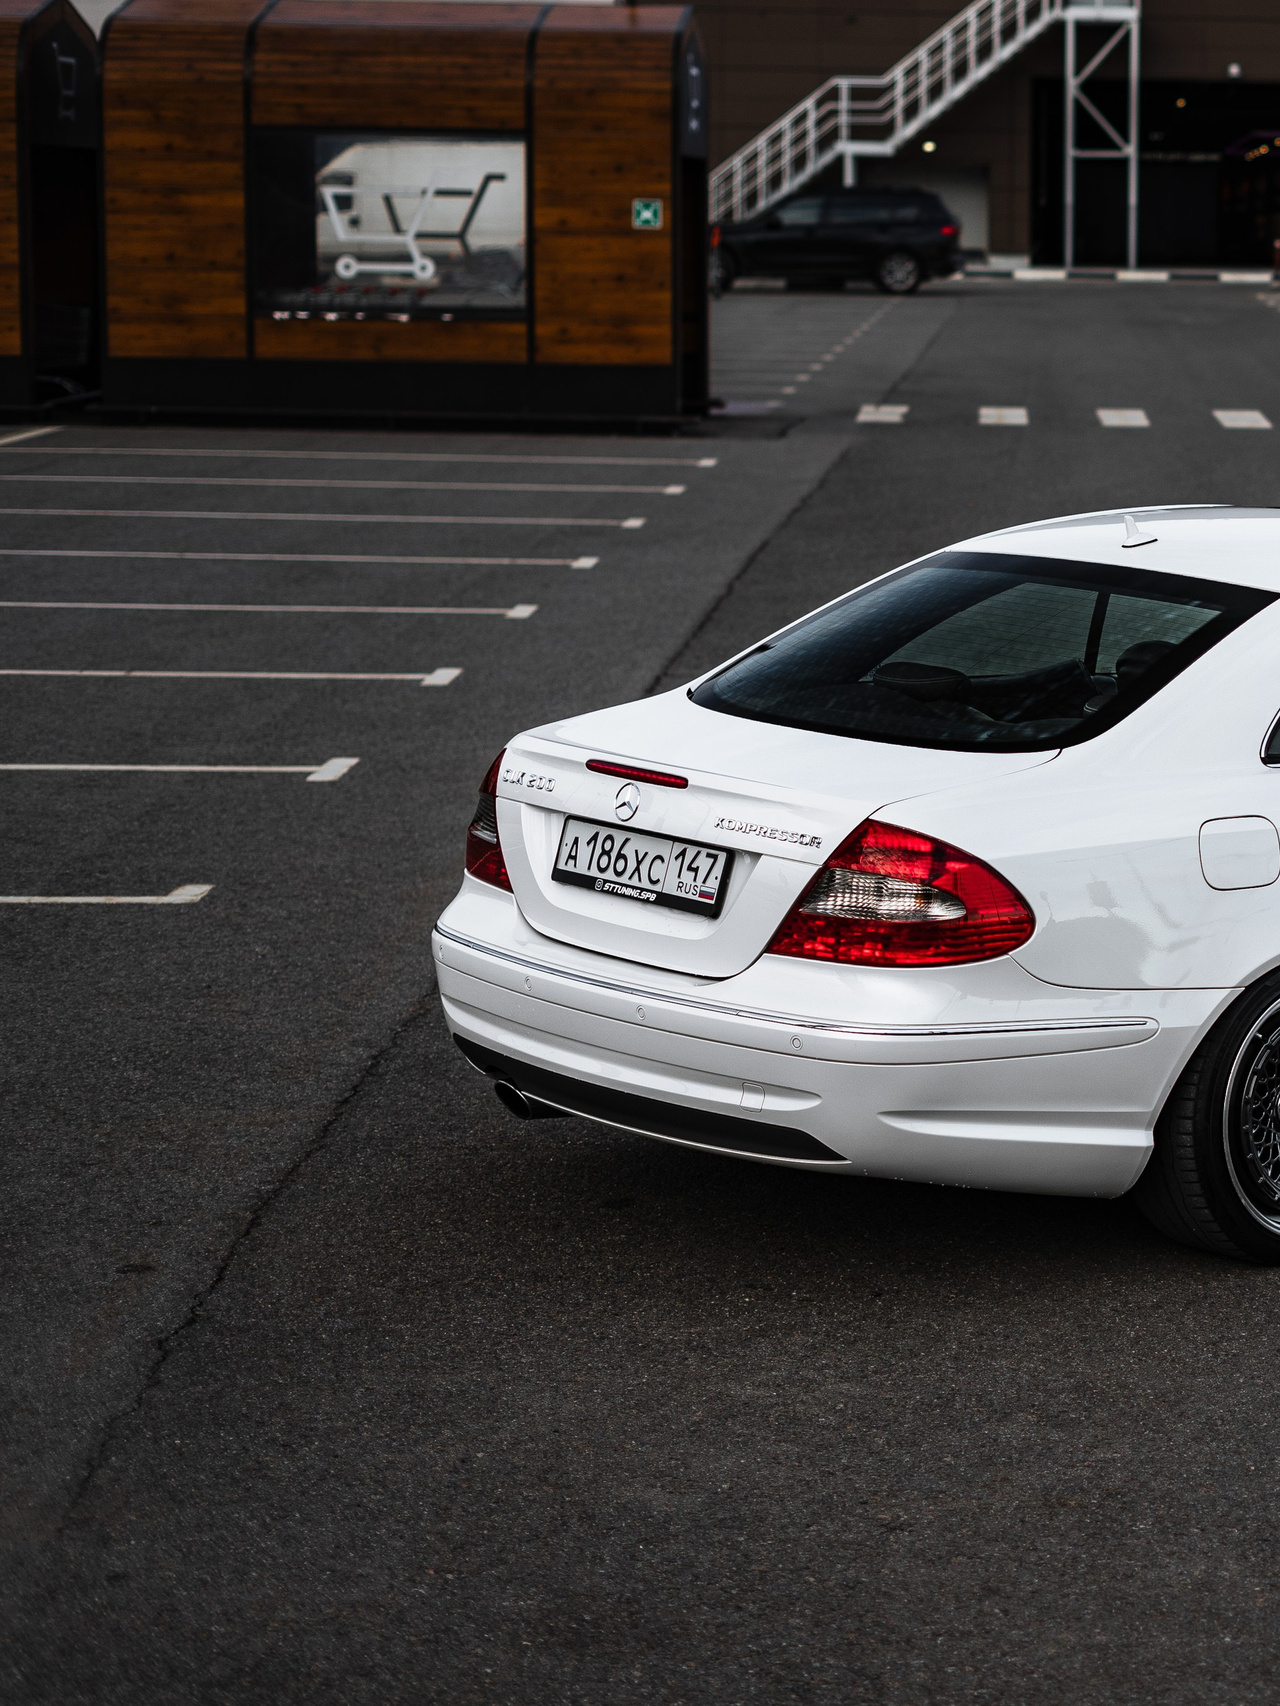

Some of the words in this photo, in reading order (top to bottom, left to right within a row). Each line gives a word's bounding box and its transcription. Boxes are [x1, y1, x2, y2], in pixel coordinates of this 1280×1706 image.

[503, 769, 526, 786] CLK
[527, 774, 556, 793] 200
[714, 816, 822, 849] KOMPRESSOR
[674, 847, 720, 885] 147
[603, 882, 657, 902] STTUNING.SPB
[676, 881, 699, 896] RUS
